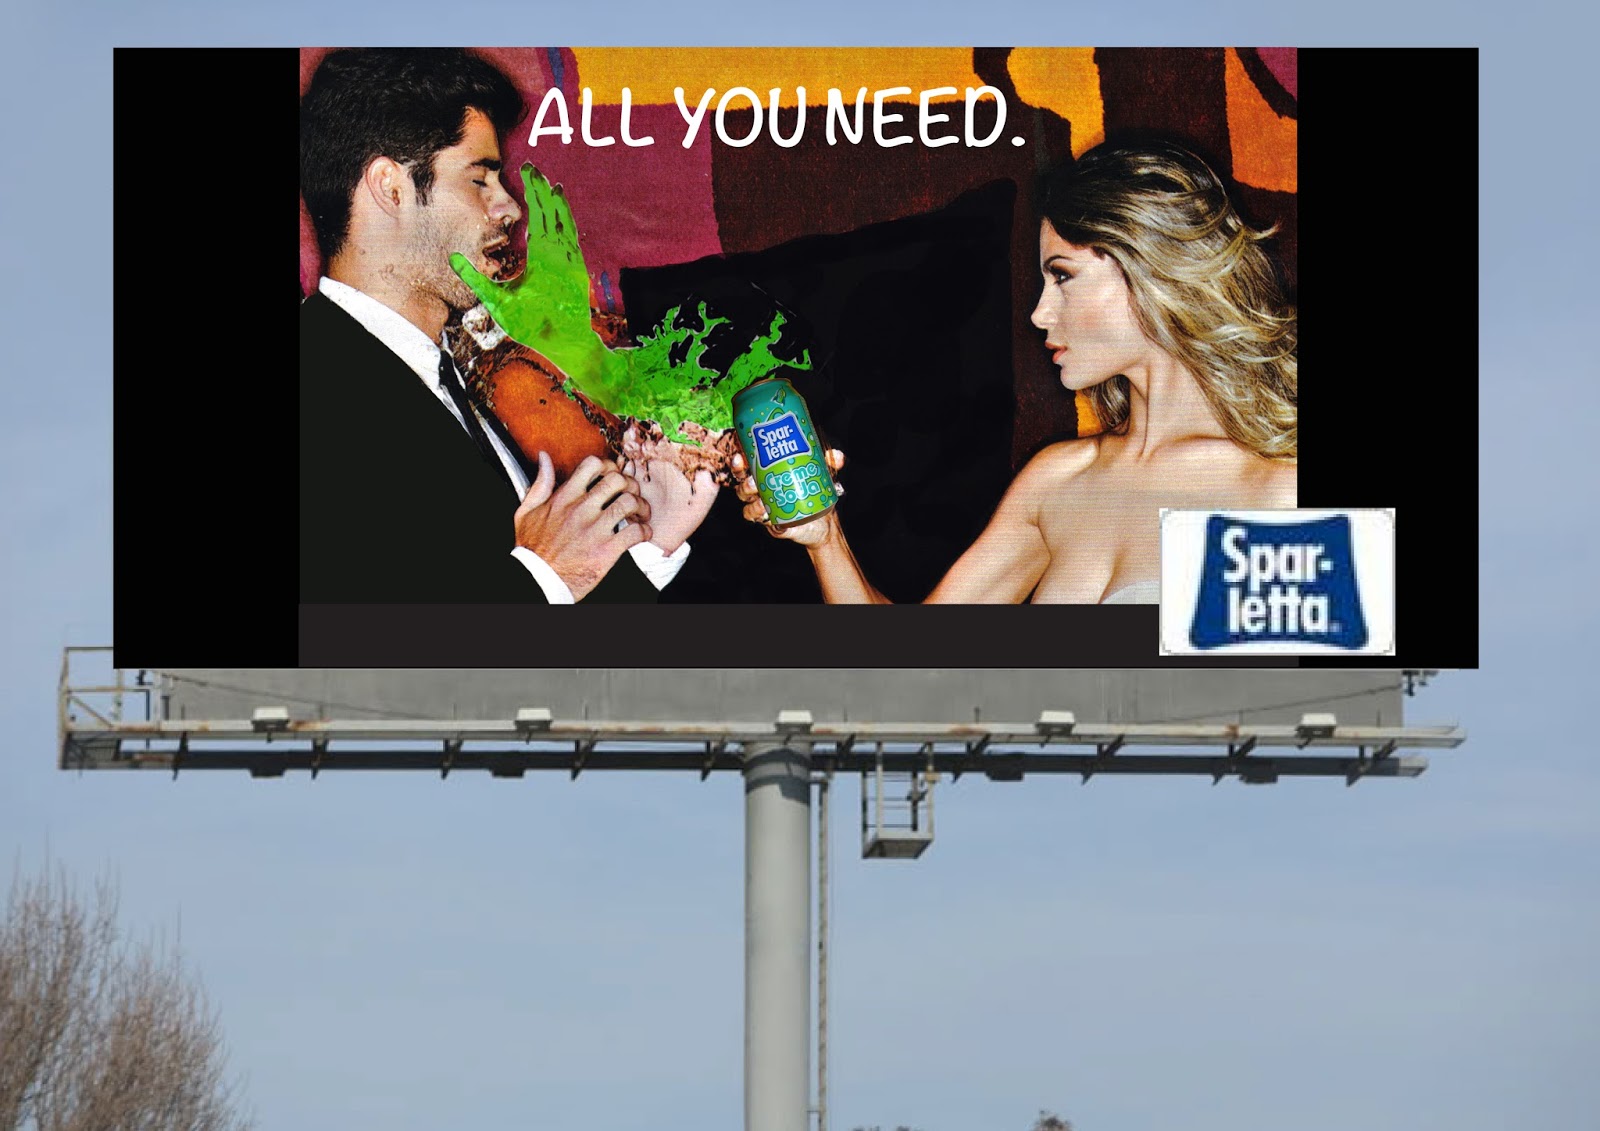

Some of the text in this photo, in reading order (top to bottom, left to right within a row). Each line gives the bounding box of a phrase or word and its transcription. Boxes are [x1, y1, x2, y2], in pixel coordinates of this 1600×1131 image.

[527, 85, 1026, 148] ALL YOU NEED.
[764, 439, 799, 461] letta
[765, 462, 819, 491] Creme
[773, 479, 821, 507] Soda
[1221, 525, 1334, 593] Spar-
